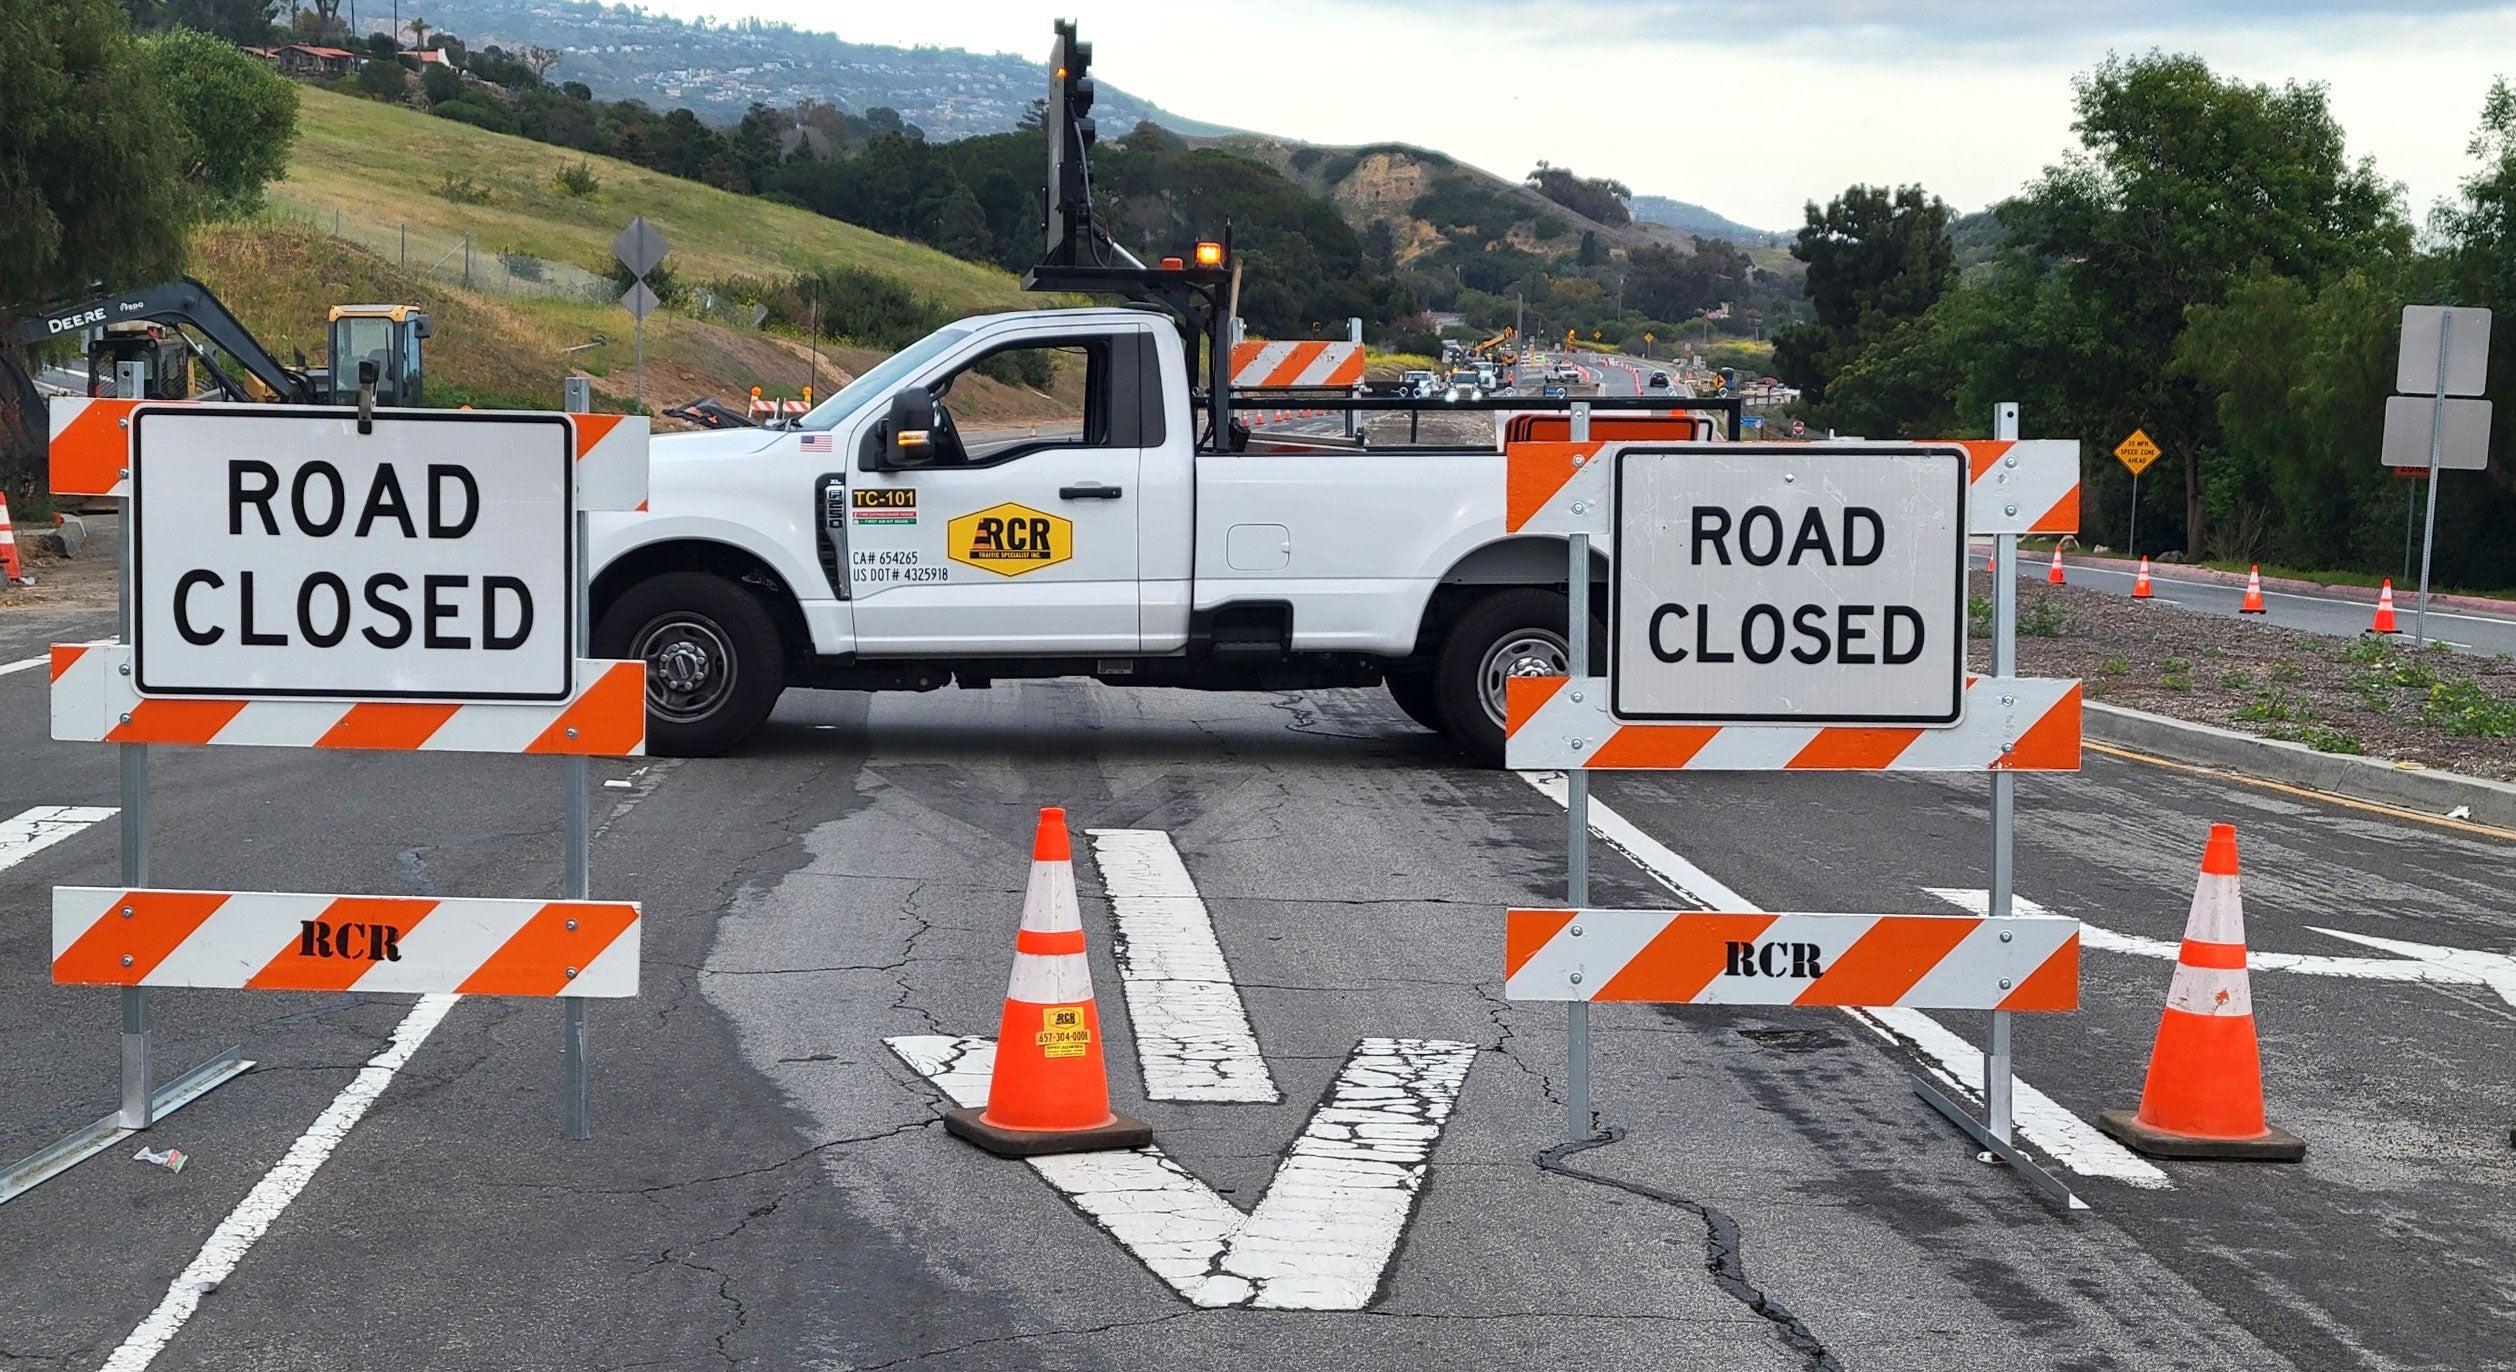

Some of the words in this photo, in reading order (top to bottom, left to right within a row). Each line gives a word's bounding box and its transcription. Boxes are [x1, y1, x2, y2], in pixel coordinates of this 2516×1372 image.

[48, 308, 107, 333] DEERE
[229, 460, 479, 538] ROAD
[854, 491, 914, 506] TC-101
[980, 517, 1051, 550] RCR
[1692, 506, 1884, 566] ROAD
[853, 551, 876, 565] CA#
[879, 551, 918, 565] 654265
[979, 551, 1000, 559] TRAFFIC
[1001, 551, 1030, 559] SPECIALIST
[1031, 551, 1041, 559] INC.
[853, 568, 867, 582] US
[870, 568, 900, 581] DOT#
[904, 567, 949, 581] 4325918
[174, 569, 533, 650] CLOSED
[1649, 603, 1924, 664] CLOSED
[299, 920, 402, 962] RCR
[1724, 941, 1824, 979] RCR
[1057, 1013, 1075, 1022] RCR
